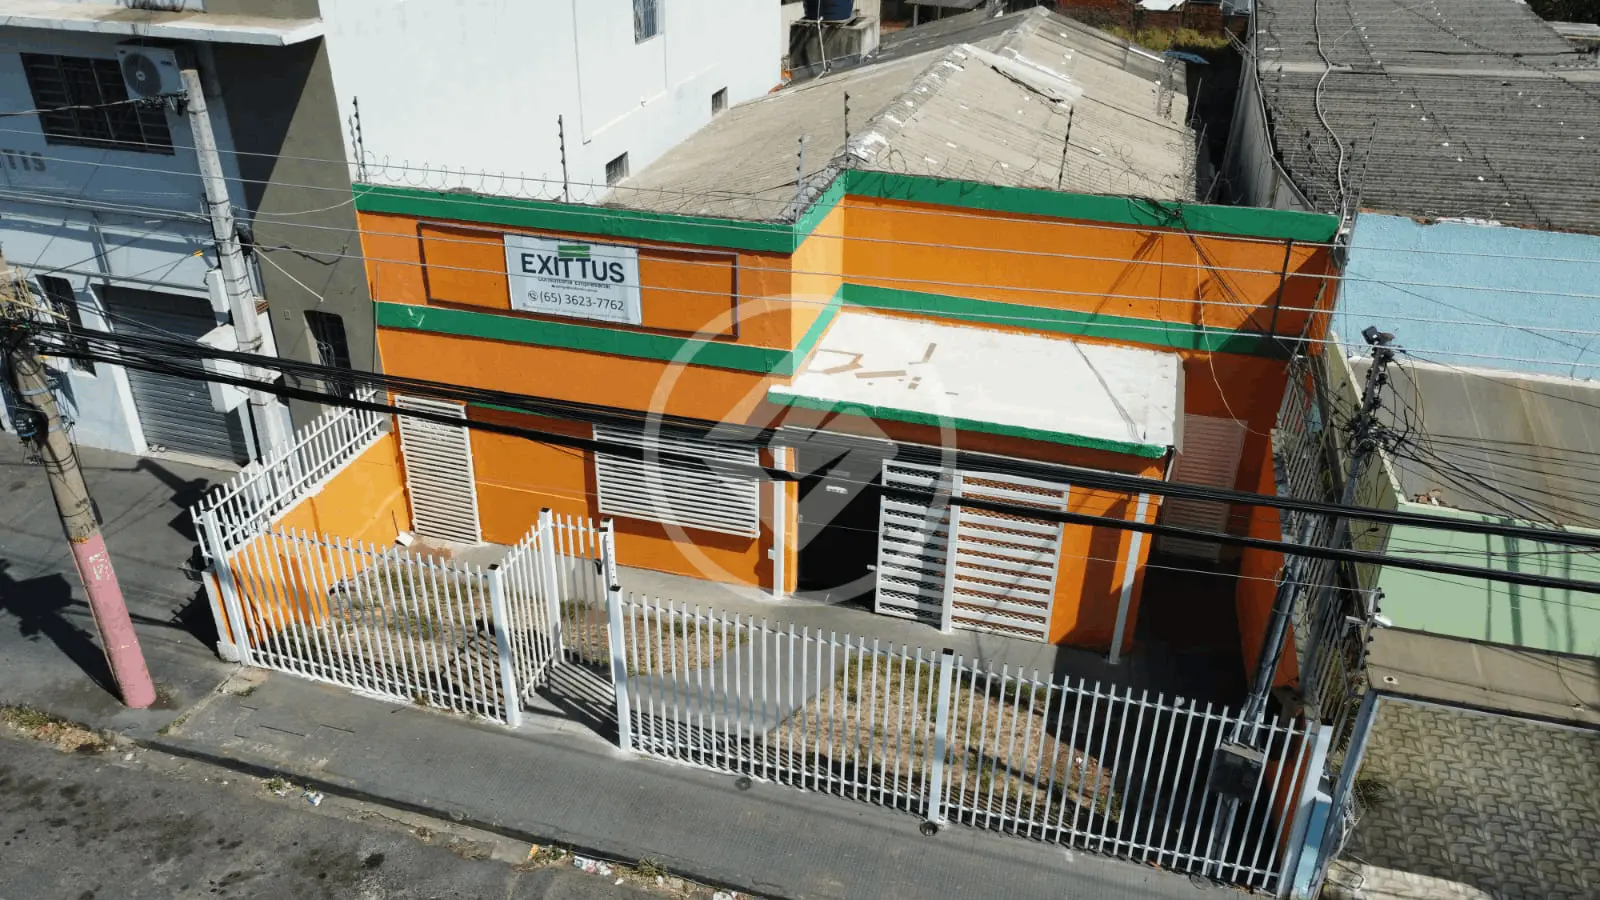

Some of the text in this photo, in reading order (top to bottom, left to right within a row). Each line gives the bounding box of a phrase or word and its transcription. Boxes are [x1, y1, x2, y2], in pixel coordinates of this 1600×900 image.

[0, 149, 46, 172] TIS
[520, 253, 625, 283] EXITTUS
[540, 290, 562, 305] (65)
[564, 294, 624, 311] 3623-7762
